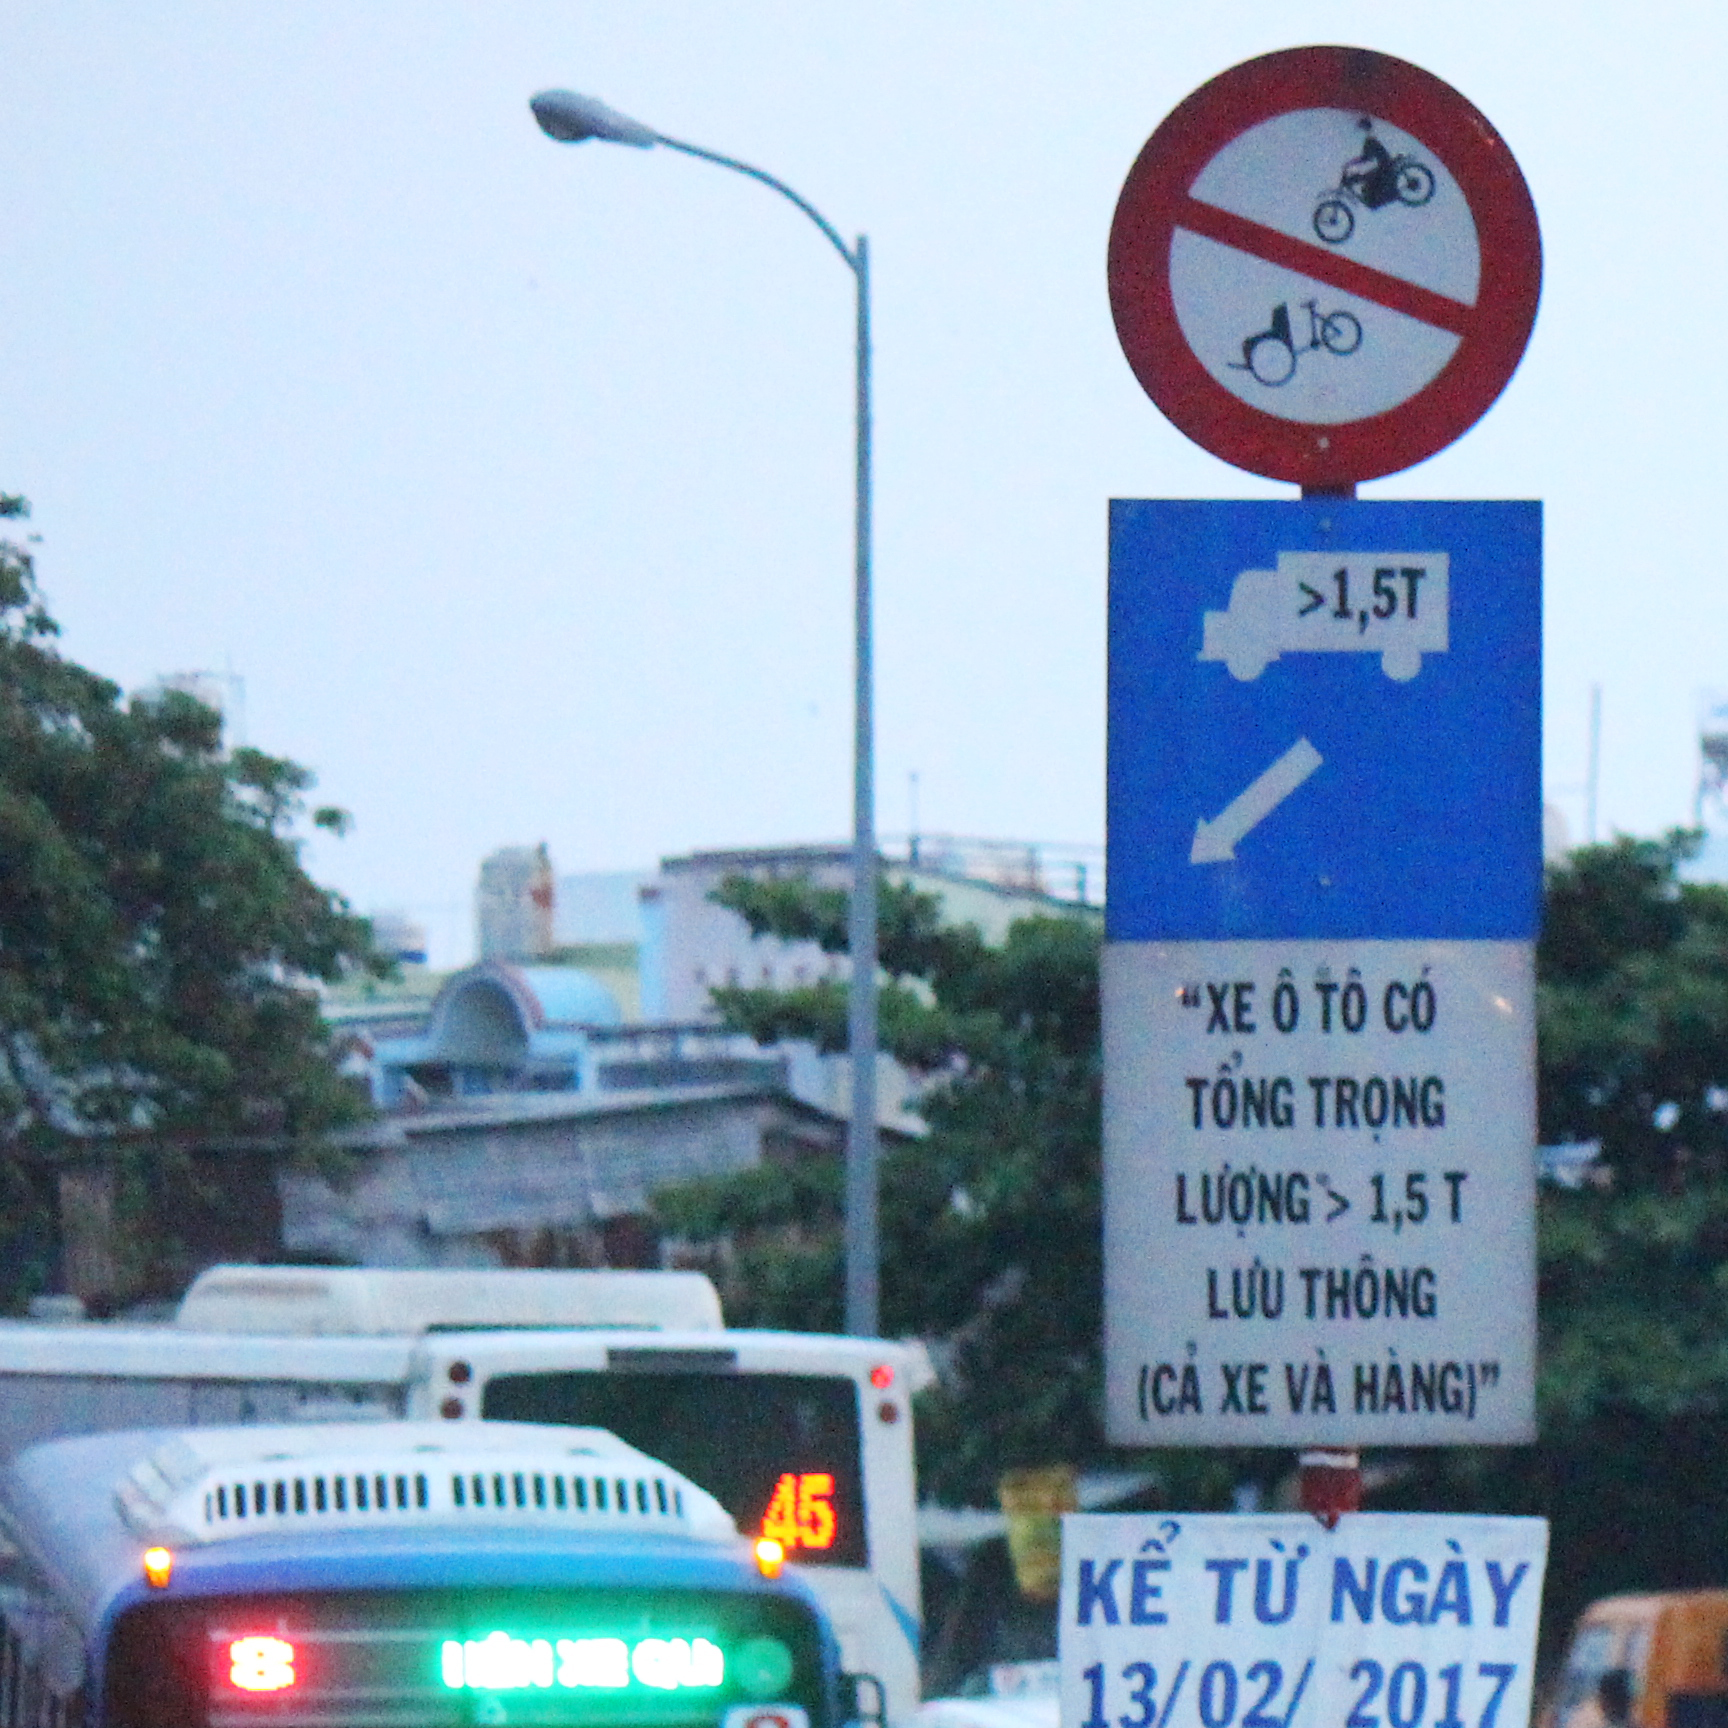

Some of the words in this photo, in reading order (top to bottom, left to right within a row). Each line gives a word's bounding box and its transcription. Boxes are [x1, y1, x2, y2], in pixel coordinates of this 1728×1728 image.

[1272, 966, 1298, 1034] Ô
[1314, 966, 1368, 1034] TÔ
[1383, 965, 1437, 1034] CÓ
[1186, 1050, 1295, 1131] TỔNG
[1308, 1075, 1446, 1143] TRỌNG
[1175, 1162, 1311, 1238] LƯỢNG
[1206, 1255, 1285, 1320] LƯU
[1299, 1253, 1438, 1320] THÔNG
[1219, 1363, 1270, 1416] XE
[1284, 1346, 1338, 1415] VÀ
[761, 1472, 838, 1549] 45
[1076, 1520, 1183, 1627] KỂ
[1205, 1538, 1310, 1626] TỪ
[1329, 1539, 1531, 1628] NGÀY
